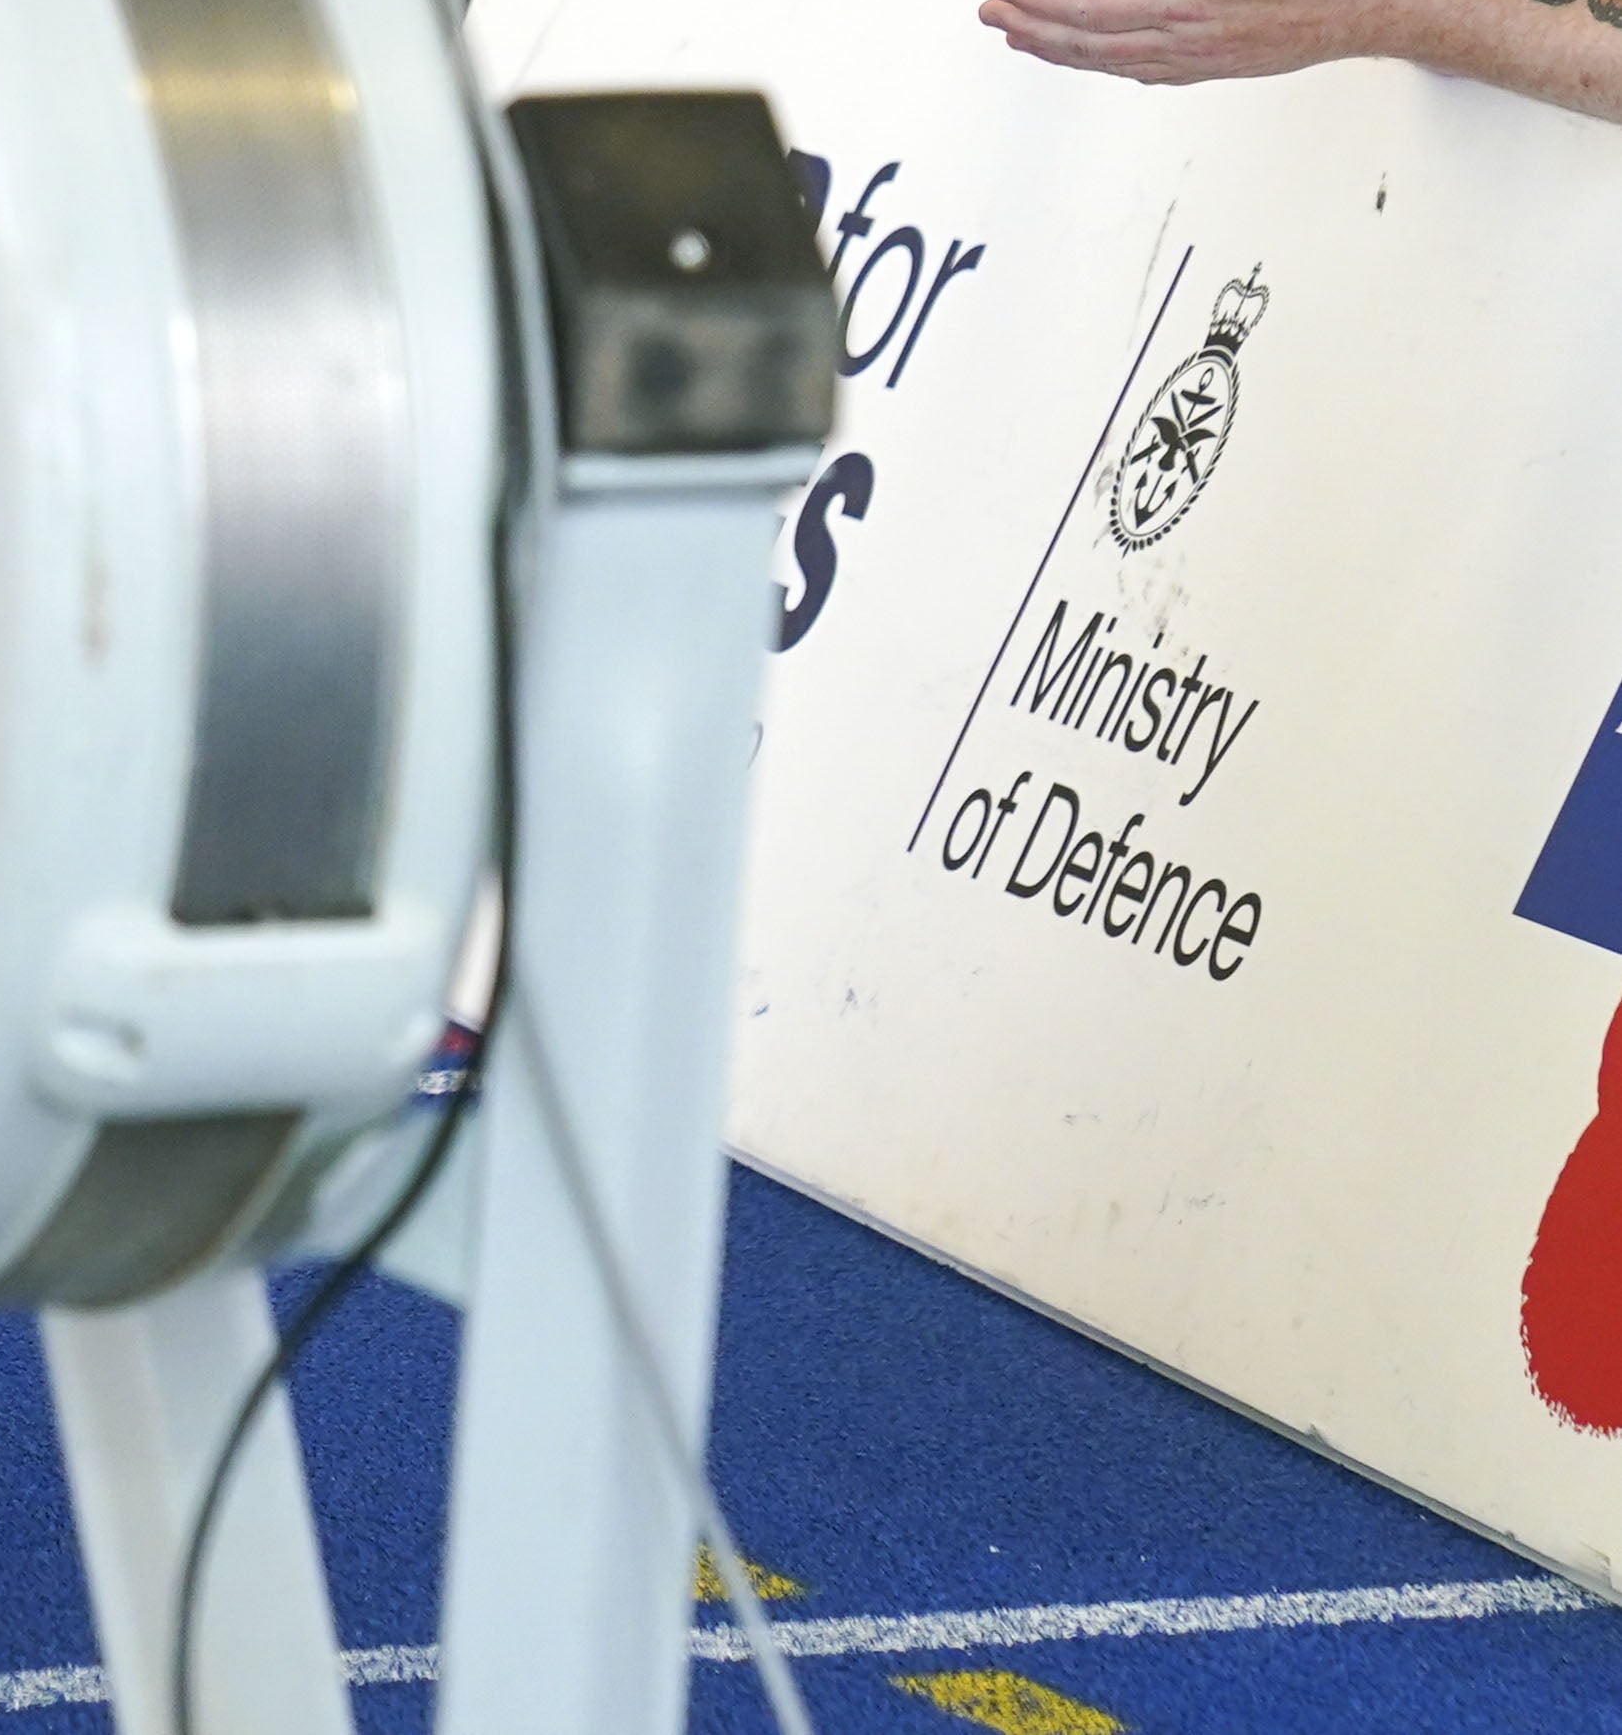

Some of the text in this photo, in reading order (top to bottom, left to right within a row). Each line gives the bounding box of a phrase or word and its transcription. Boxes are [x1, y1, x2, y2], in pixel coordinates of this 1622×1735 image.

[826, 161, 987, 389] for
[1010, 599, 1260, 806] Ministry
[941, 770, 1264, 982] of Defence
